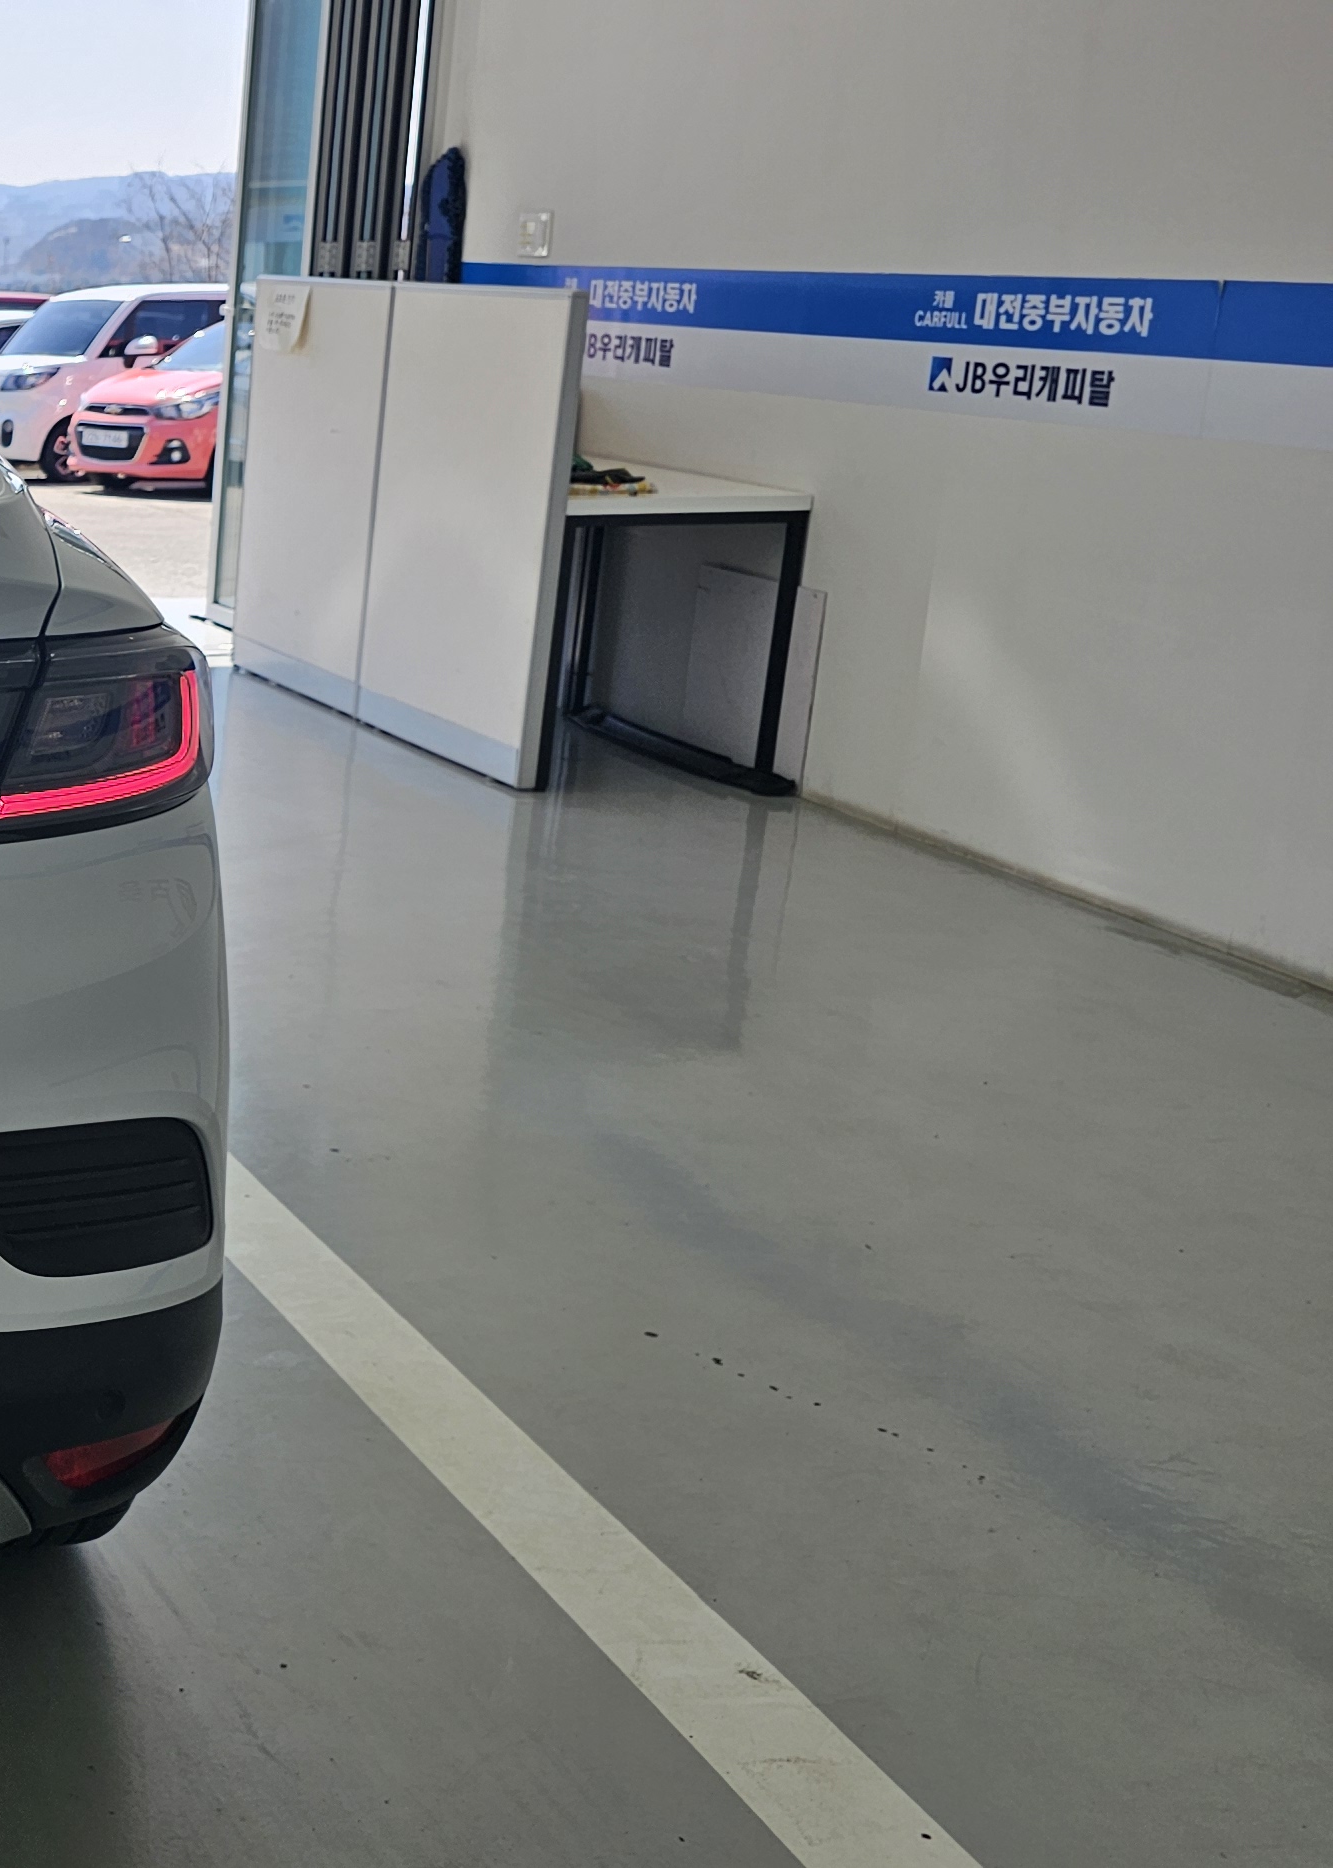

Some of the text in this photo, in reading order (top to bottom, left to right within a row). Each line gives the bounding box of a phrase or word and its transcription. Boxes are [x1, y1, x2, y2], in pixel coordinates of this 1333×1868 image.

[589, 279, 697, 314] 대전중부자동차
[973, 292, 1154, 338] 대전중부자동차
[914, 309, 968, 329] CARFULL
[586, 332, 675, 369] B우리캐피탈
[954, 360, 1116, 408] JB우리캐피탈
